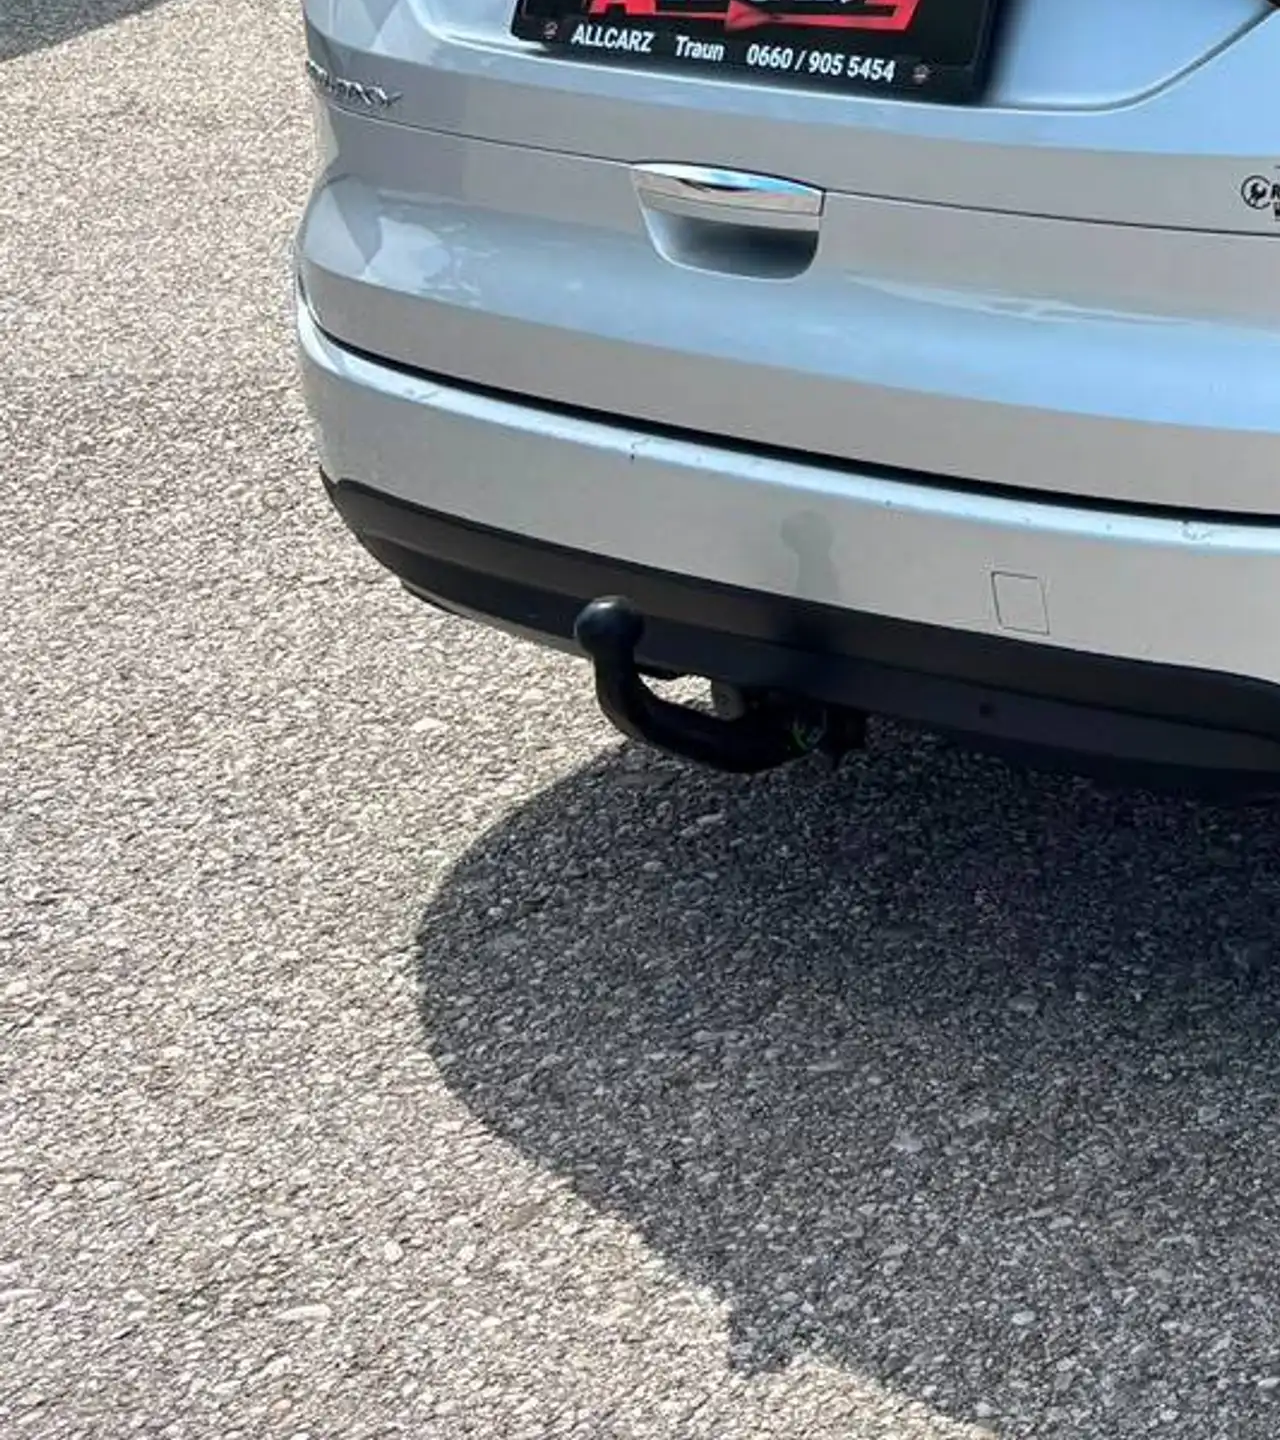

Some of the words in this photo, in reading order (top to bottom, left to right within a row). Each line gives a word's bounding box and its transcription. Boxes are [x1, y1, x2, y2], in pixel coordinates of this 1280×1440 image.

[571, 23, 654, 53] ALLCARZ
[675, 35, 724, 62] Traun
[746, 43, 793, 69] 0660
[795, 49, 806, 72] /
[808, 50, 844, 76] 905
[846, 55, 897, 83] 5454
